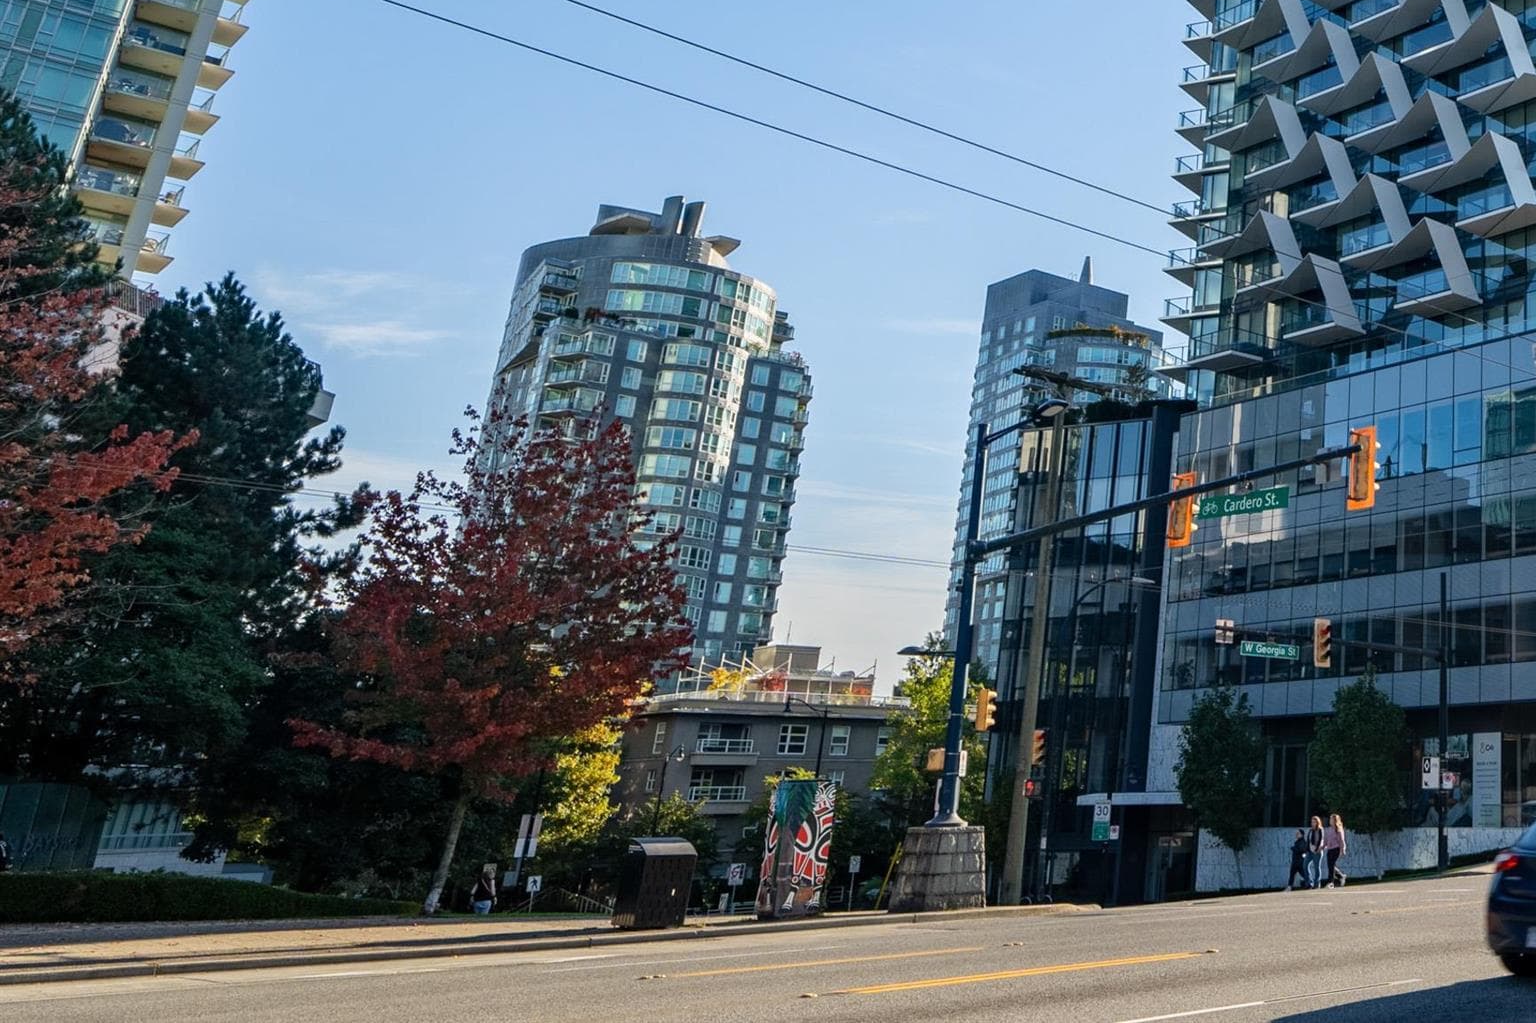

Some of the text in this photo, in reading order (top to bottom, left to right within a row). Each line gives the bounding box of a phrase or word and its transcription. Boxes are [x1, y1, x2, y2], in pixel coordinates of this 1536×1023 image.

[1223, 492, 1280, 513] Cardero St.
[1245, 644, 1296, 657] W Georgia St
[1095, 805, 1109, 817] 30
